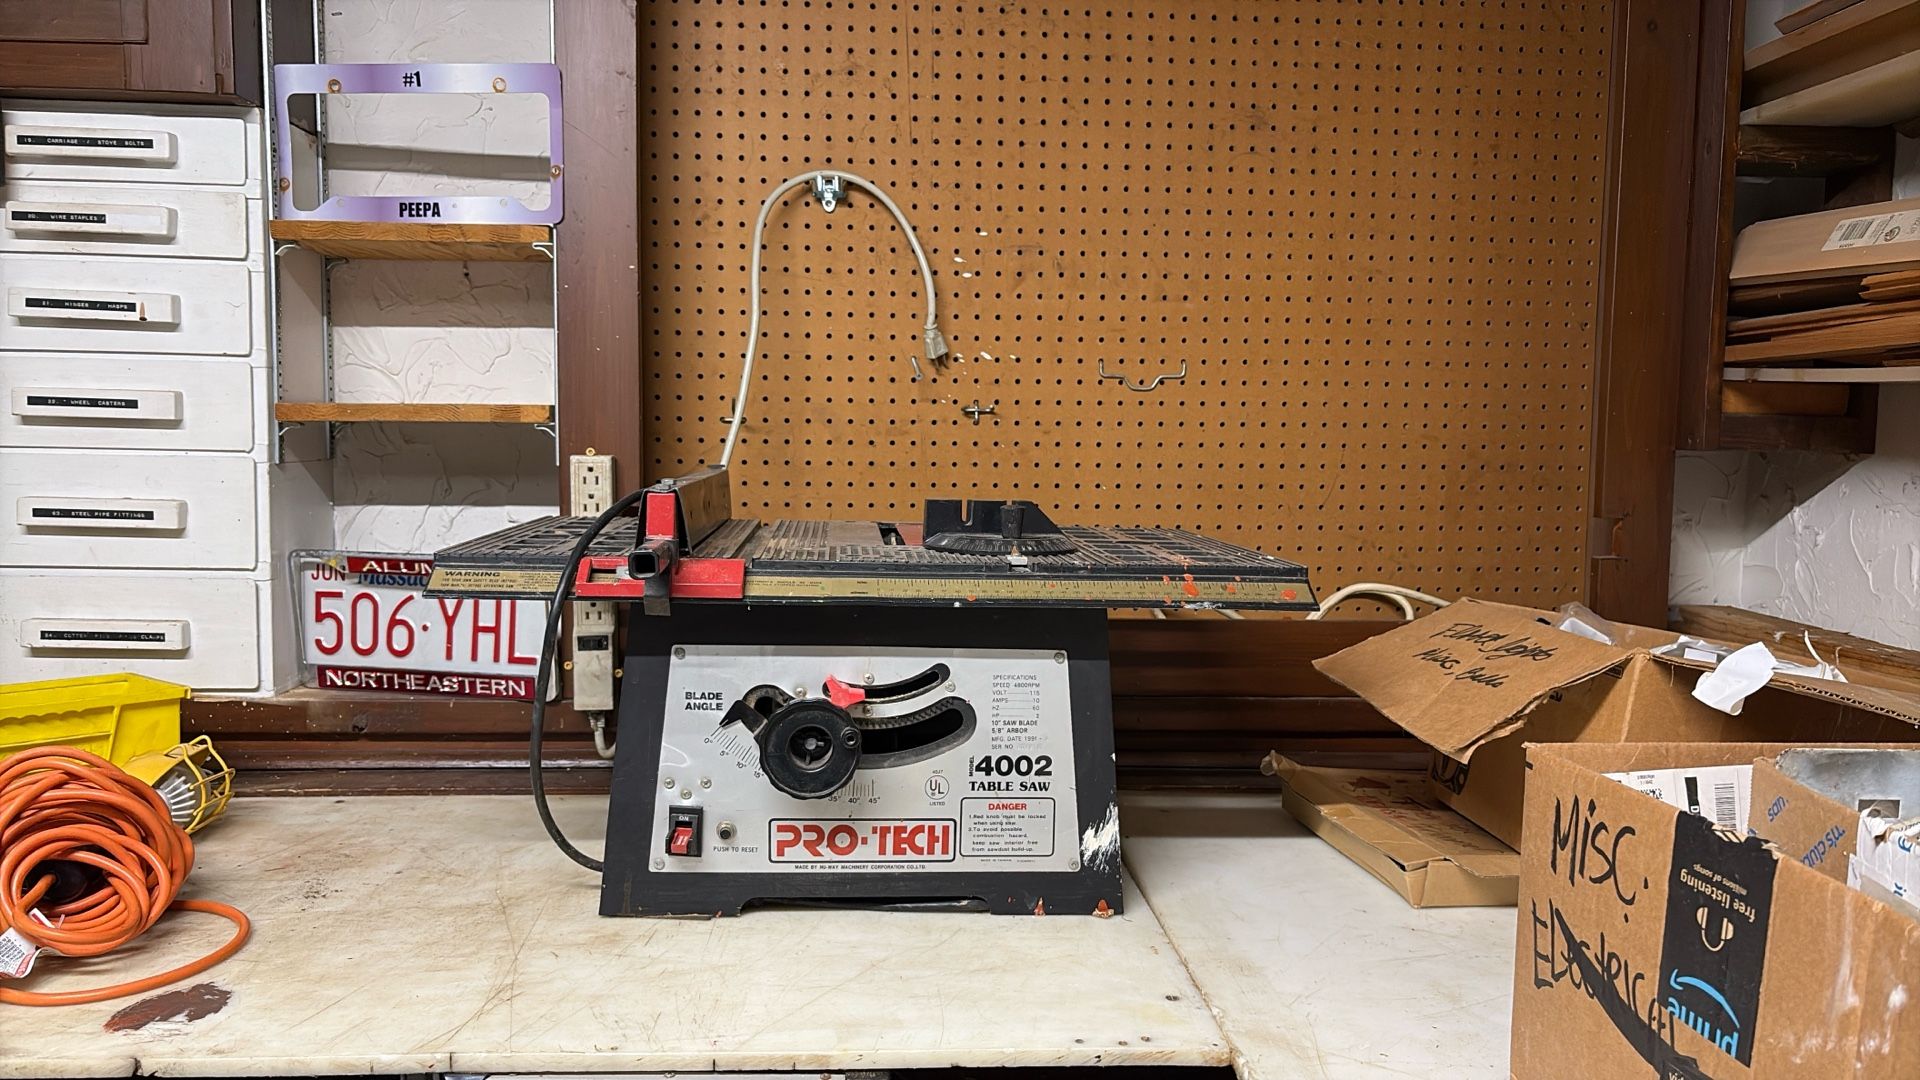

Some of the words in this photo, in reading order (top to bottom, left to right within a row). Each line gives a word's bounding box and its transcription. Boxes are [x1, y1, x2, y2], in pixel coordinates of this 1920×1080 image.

[402, 71, 422, 87] #1
[399, 202, 440, 218] PEEPA
[326, 670, 525, 696] NORTHEASTERN
[685, 692, 723, 700] BLADE
[975, 755, 1052, 776] 4002
[930, 780, 944, 794] UL
[969, 781, 1014, 791] TABLE
[1019, 781, 1050, 791] SAW
[1692, 863, 1712, 878] songs
[1712, 873, 1722, 882] of
[1680, 868, 1731, 909] listening
[1732, 899, 1756, 922] free
